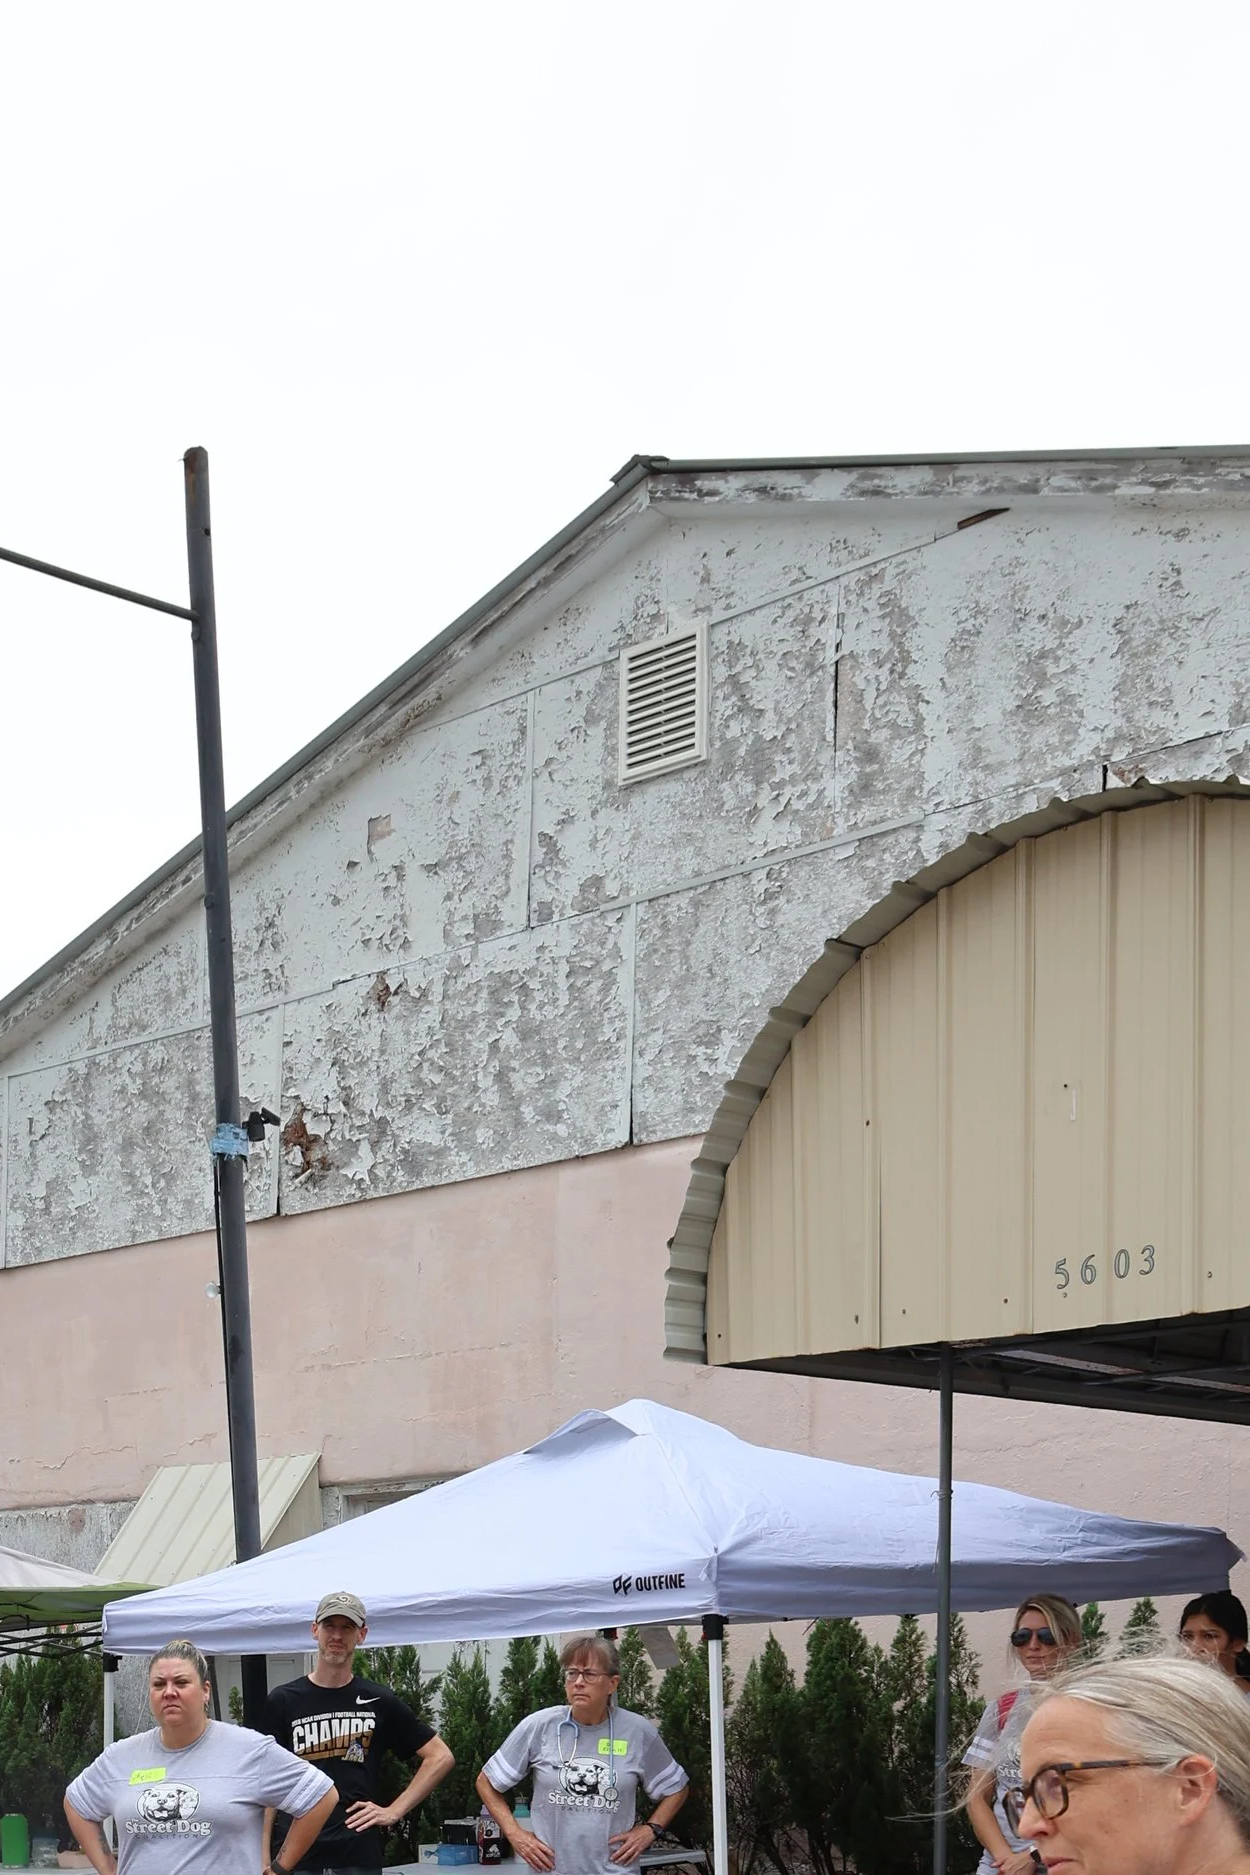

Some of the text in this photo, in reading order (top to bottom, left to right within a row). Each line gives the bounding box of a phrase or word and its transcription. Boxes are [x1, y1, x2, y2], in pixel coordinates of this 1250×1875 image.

[1054, 1244, 1156, 1290] 5603
[635, 1573, 686, 1591] OUTFINE
[292, 1718, 376, 1755] CHAMPS
[549, 1792, 591, 1807] Street
[125, 1820, 211, 1836] Street Dog
